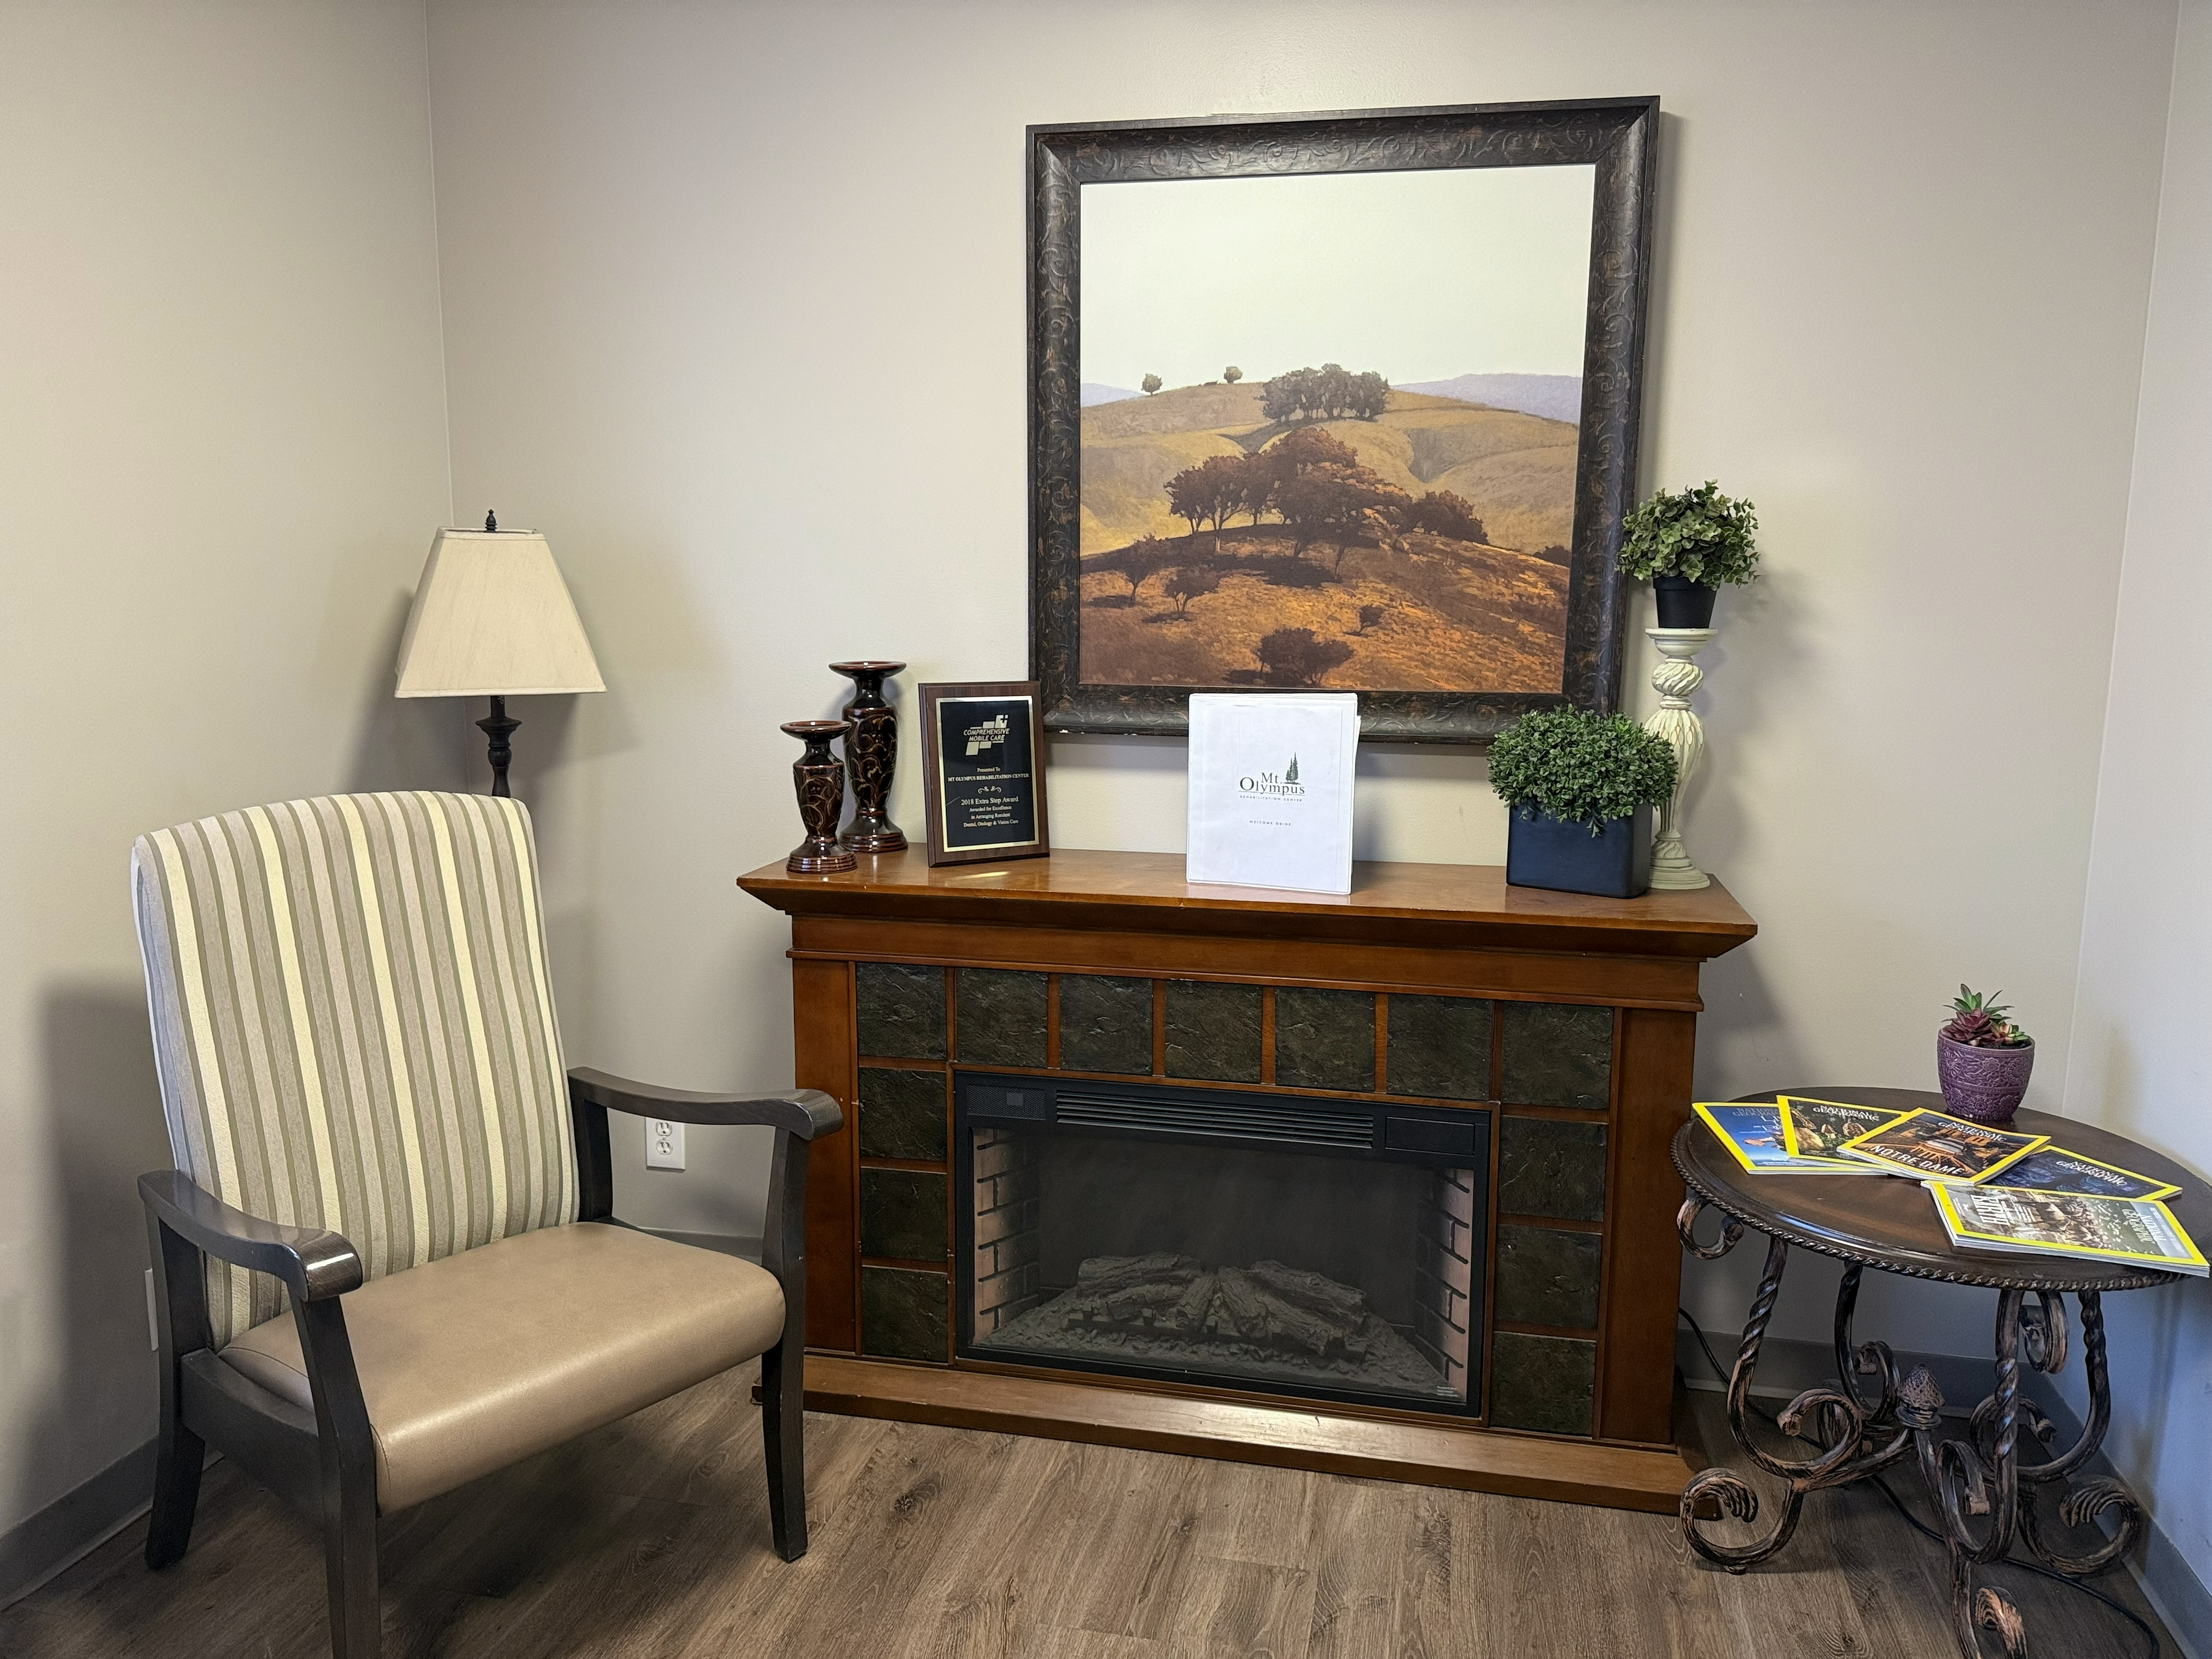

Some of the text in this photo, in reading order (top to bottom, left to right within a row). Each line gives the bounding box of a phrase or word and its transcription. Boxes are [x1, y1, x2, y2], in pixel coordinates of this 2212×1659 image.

[1240, 777, 1305, 796] Olympus
[1820, 1105, 1872, 1117] NATIONAL
[1950, 1121, 1999, 1140] NATIONAL
[1870, 1145, 1920, 1164] NOTRE
[1920, 1159, 1965, 1175] DAME
[2070, 1160, 2124, 1182] NATIONAL
[1971, 1195, 2011, 1226] EARTH
[2121, 1209, 2156, 1244] GEOGRAPHIC
[2138, 1213, 2166, 1241] NATIONAL
